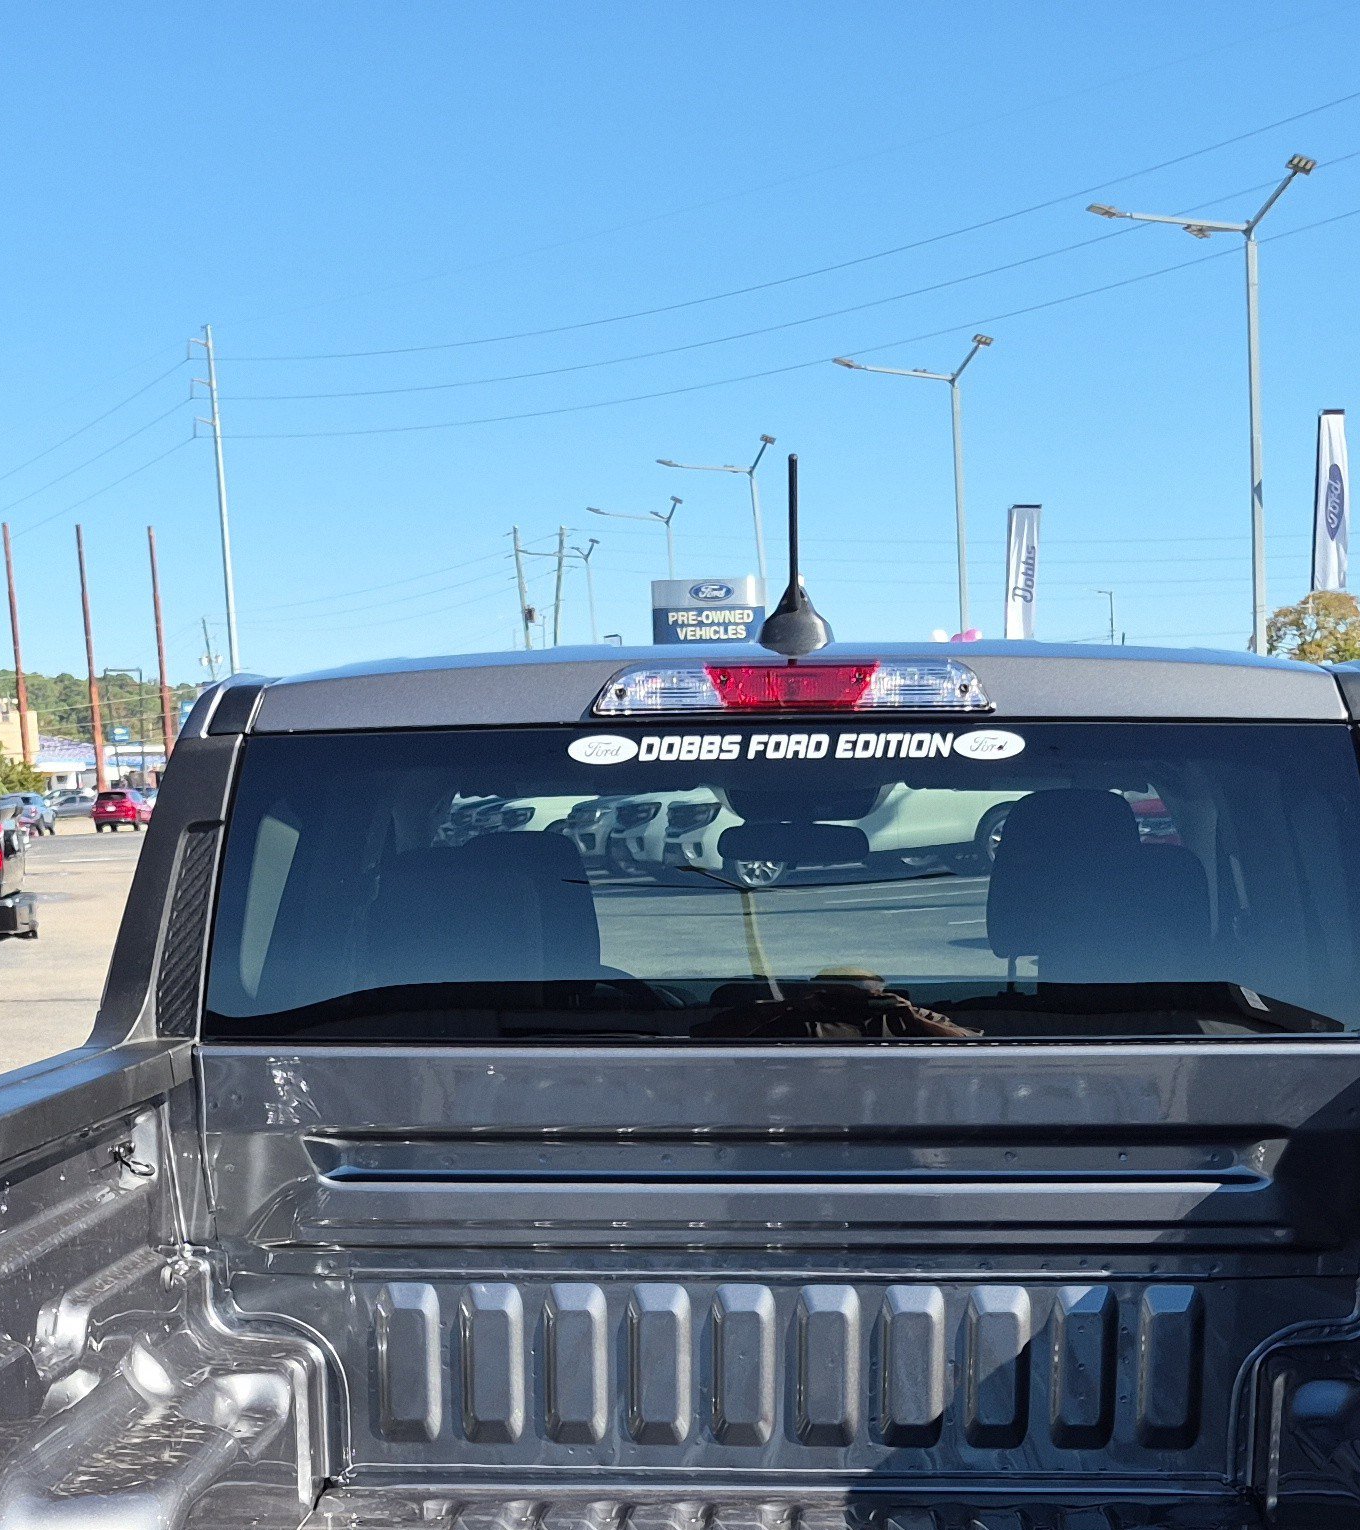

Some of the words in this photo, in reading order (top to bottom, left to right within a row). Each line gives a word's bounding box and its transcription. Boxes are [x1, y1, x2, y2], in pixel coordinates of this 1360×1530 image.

[668, 609, 754, 625] PRE-OWNED
[676, 624, 747, 640] VEHICLES
[584, 741, 621, 757] Ford
[639, 735, 742, 761] DOBBS
[747, 733, 830, 760] FORD
[835, 732, 955, 758] EDITION
[969, 736, 1008, 752] Ford
